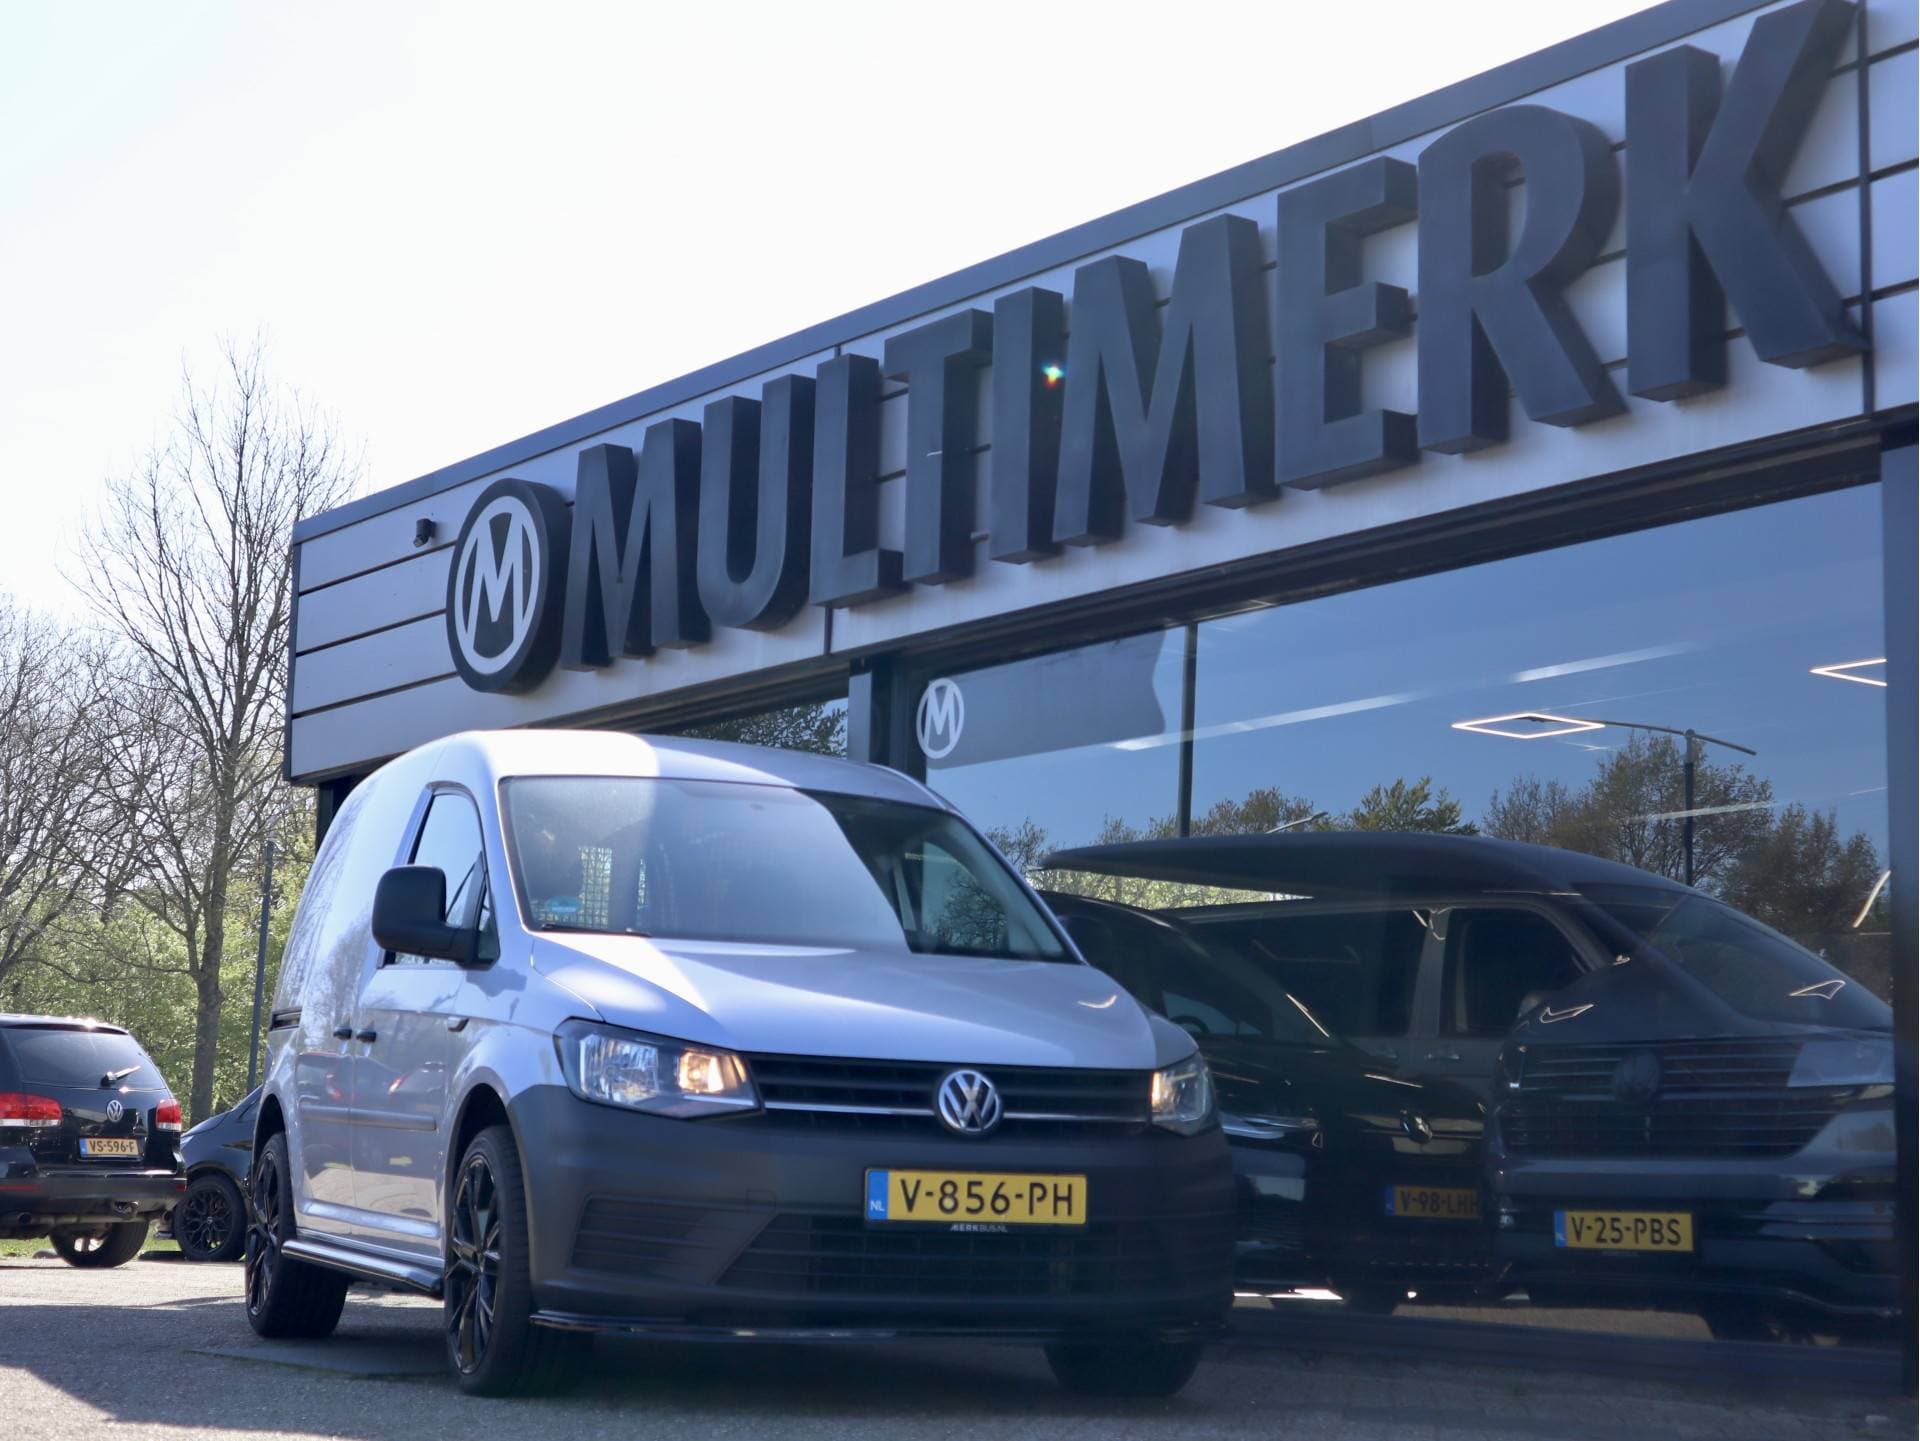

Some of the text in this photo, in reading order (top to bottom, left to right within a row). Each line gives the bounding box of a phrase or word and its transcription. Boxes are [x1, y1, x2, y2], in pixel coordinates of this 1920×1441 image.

[457, 0, 1869, 671] M MULTIMERK
[919, 680, 962, 755] M
[89, 1140, 134, 1152] VS-596-F
[870, 1178, 1073, 1217] NL V-856-PH
[1570, 1216, 1682, 1246] V-25-PBS
